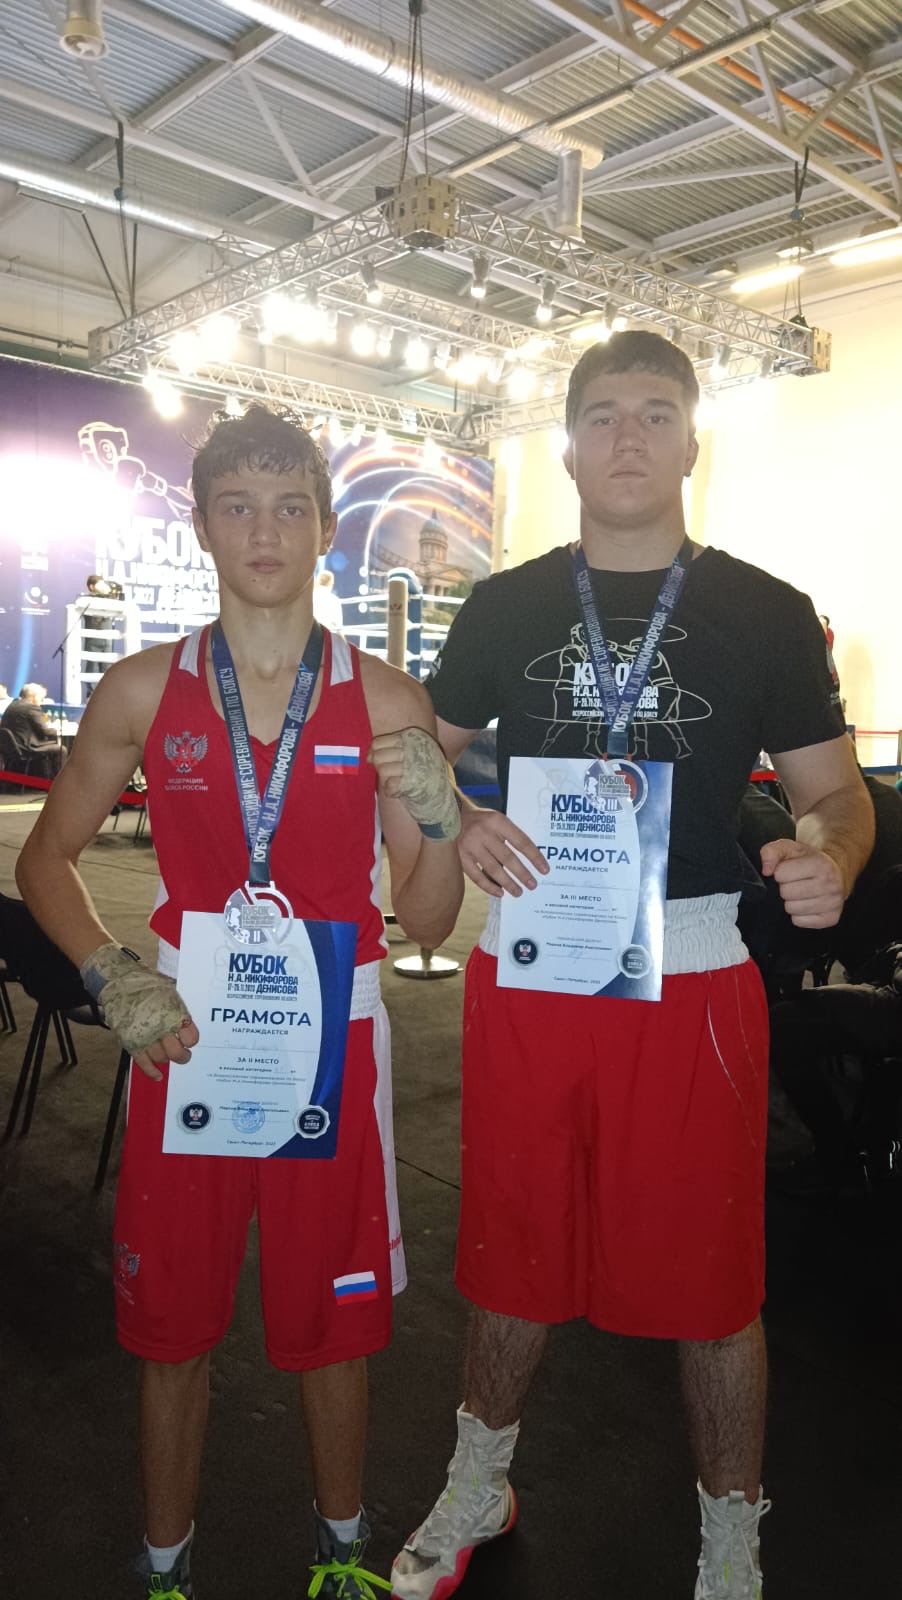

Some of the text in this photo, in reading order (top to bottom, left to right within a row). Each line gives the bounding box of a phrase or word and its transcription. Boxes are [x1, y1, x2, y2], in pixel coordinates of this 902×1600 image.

[218, 667, 237, 695] БОКСУ
[225, 695, 240, 708] ПО
[611, 700, 634, 732] КУБОК
[228, 708, 253, 776] СОРЕВНОВАНИЯ
[576, 823, 616, 833] ДЕНИСОВА
[253, 827, 272, 863] КУБОК
[555, 865, 608, 873] НАГРАЖДАЕТСЯ
[229, 952, 288, 975] КУБОК
[256, 984, 298, 994] ДЕНИСОВА
[210, 1007, 312, 1027] ГРАМОТА
